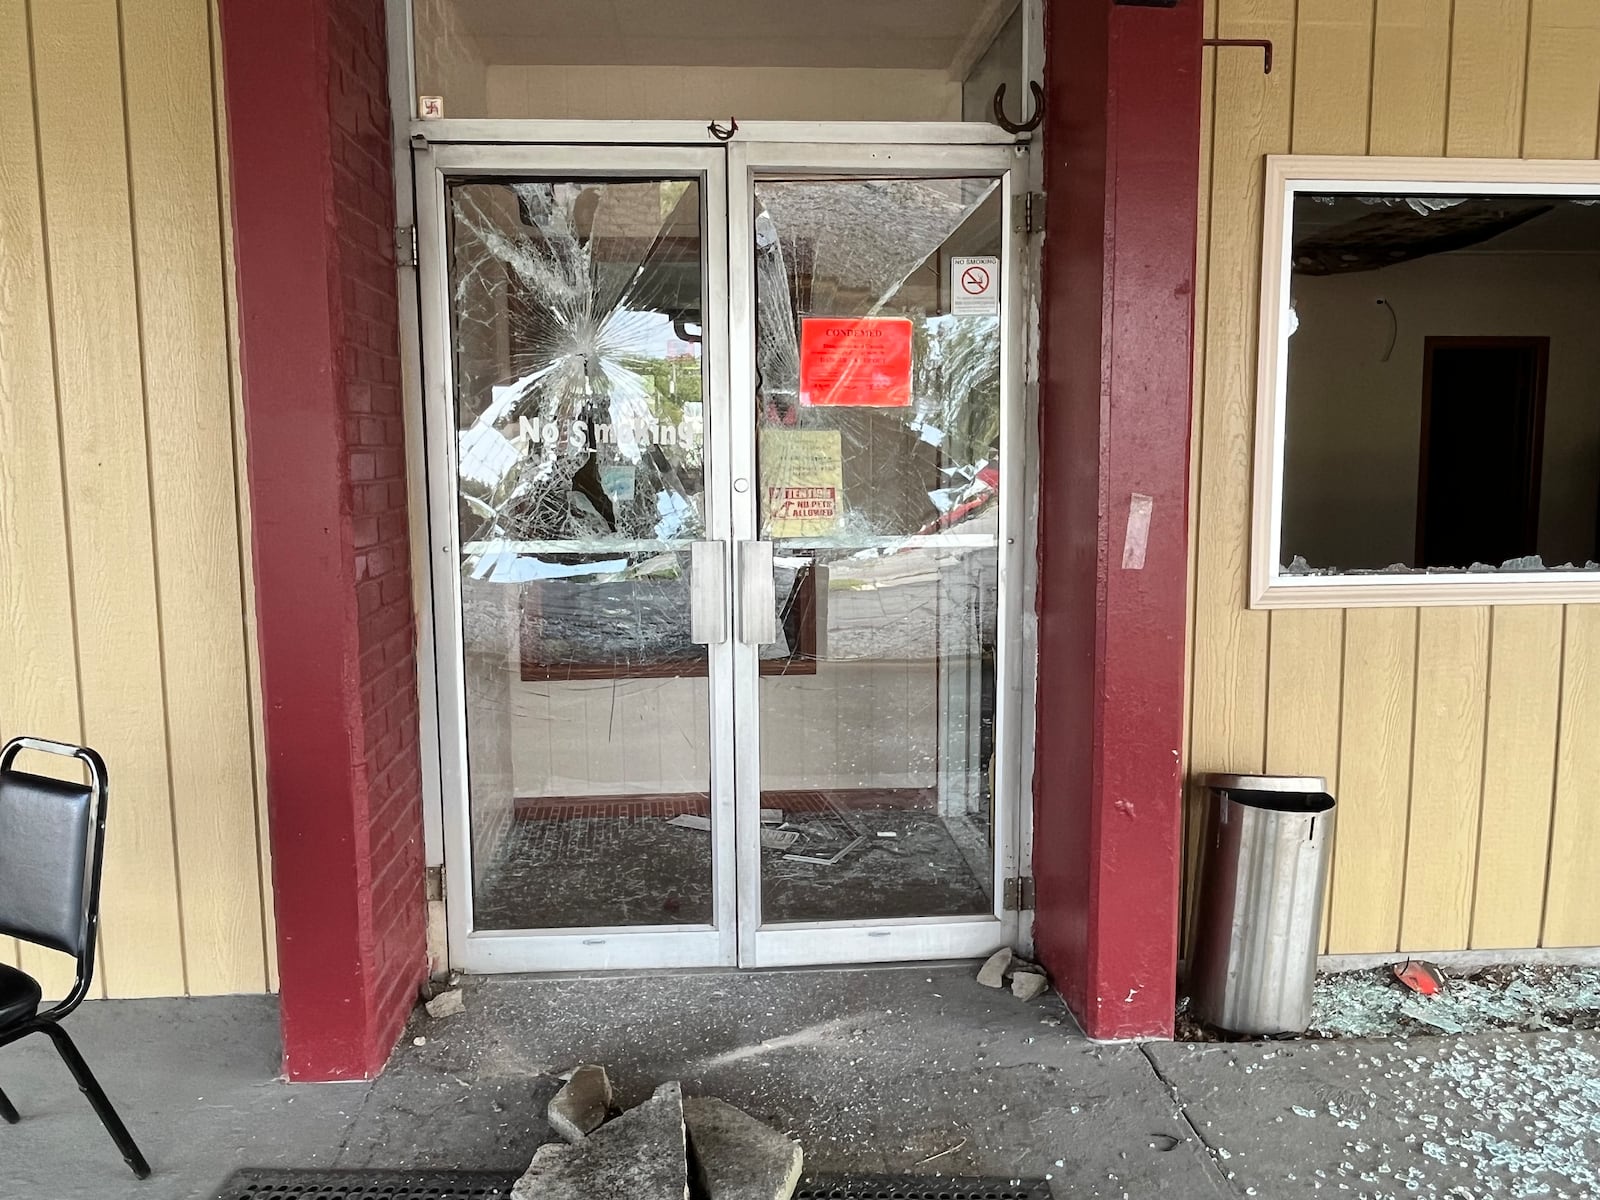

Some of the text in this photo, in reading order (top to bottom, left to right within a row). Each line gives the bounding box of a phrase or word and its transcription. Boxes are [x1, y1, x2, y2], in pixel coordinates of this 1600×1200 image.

[519, 415, 559, 443] No
[773, 488, 831, 499] TENTION
[792, 509, 833, 517] ALLOWED
